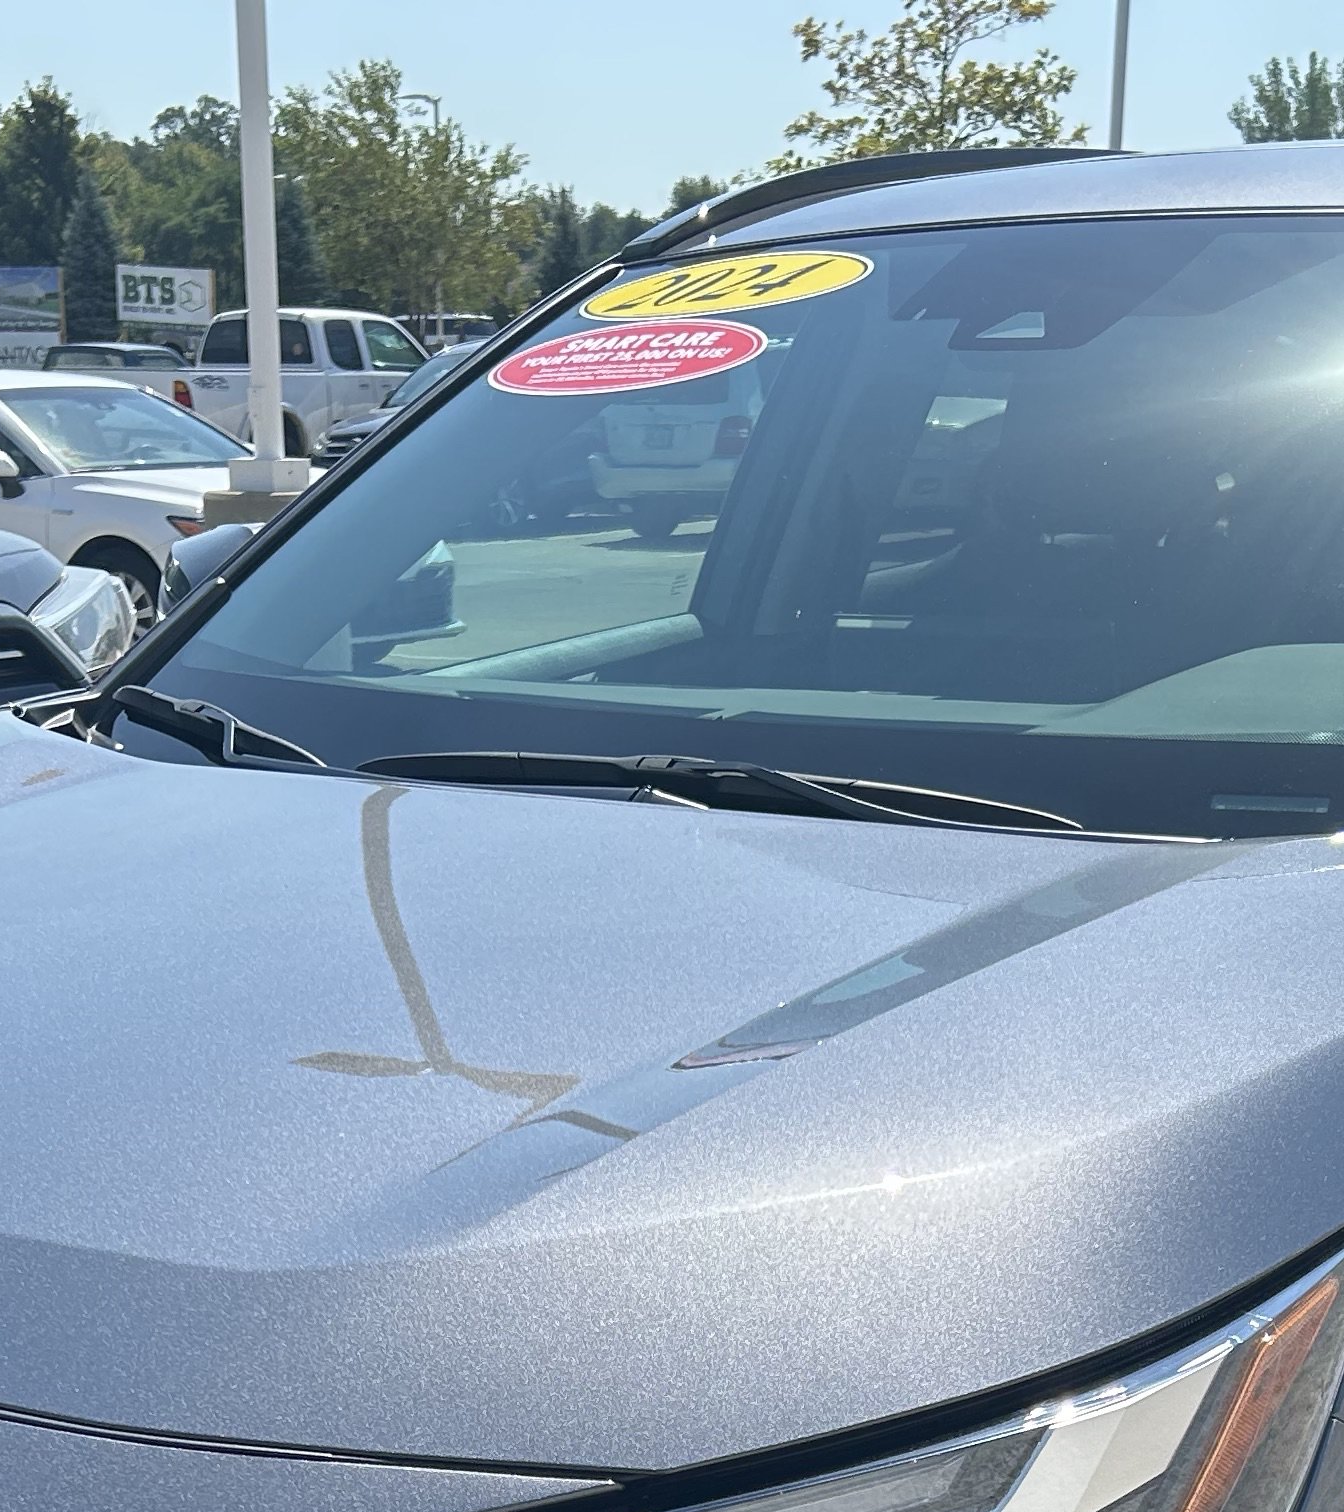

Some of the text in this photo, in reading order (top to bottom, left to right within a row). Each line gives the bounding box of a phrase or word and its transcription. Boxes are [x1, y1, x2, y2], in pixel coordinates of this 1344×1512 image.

[121, 274, 177, 306] BTS
[602, 259, 838, 313] 2024
[560, 331, 727, 354] SMART CARE
[521, 355, 568, 369] YOUR
[564, 352, 611, 364] FIRST
[609, 349, 667, 362] 25,000
[667, 348, 699, 360] ON
[697, 347, 733, 359] US!
